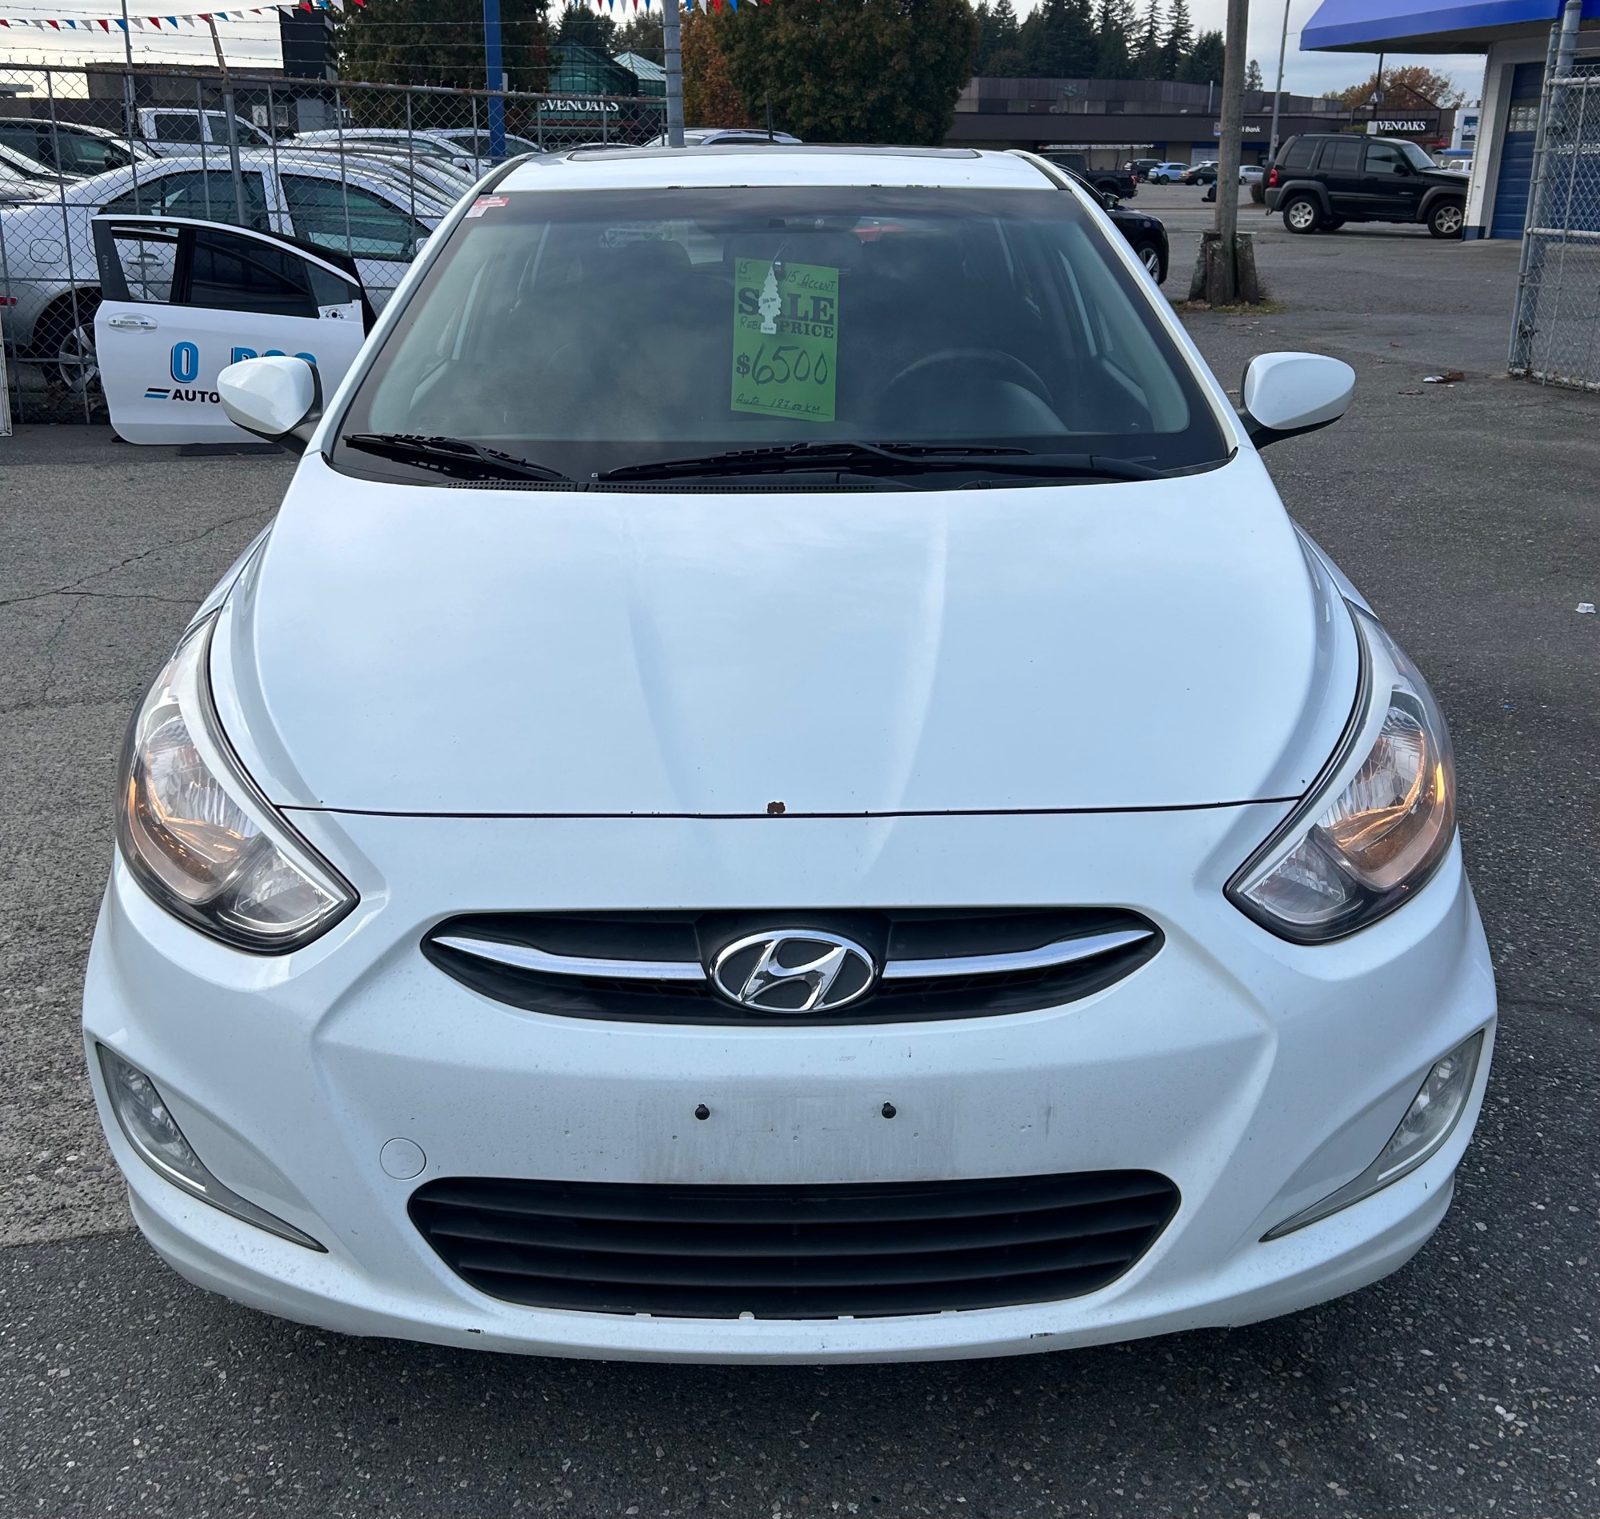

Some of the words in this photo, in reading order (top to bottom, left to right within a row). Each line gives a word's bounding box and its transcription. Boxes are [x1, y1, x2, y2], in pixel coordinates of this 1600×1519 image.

[1378, 120, 1427, 131] VENOAKS
[738, 286, 835, 325] SLE
[778, 321, 834, 339] PRICE
